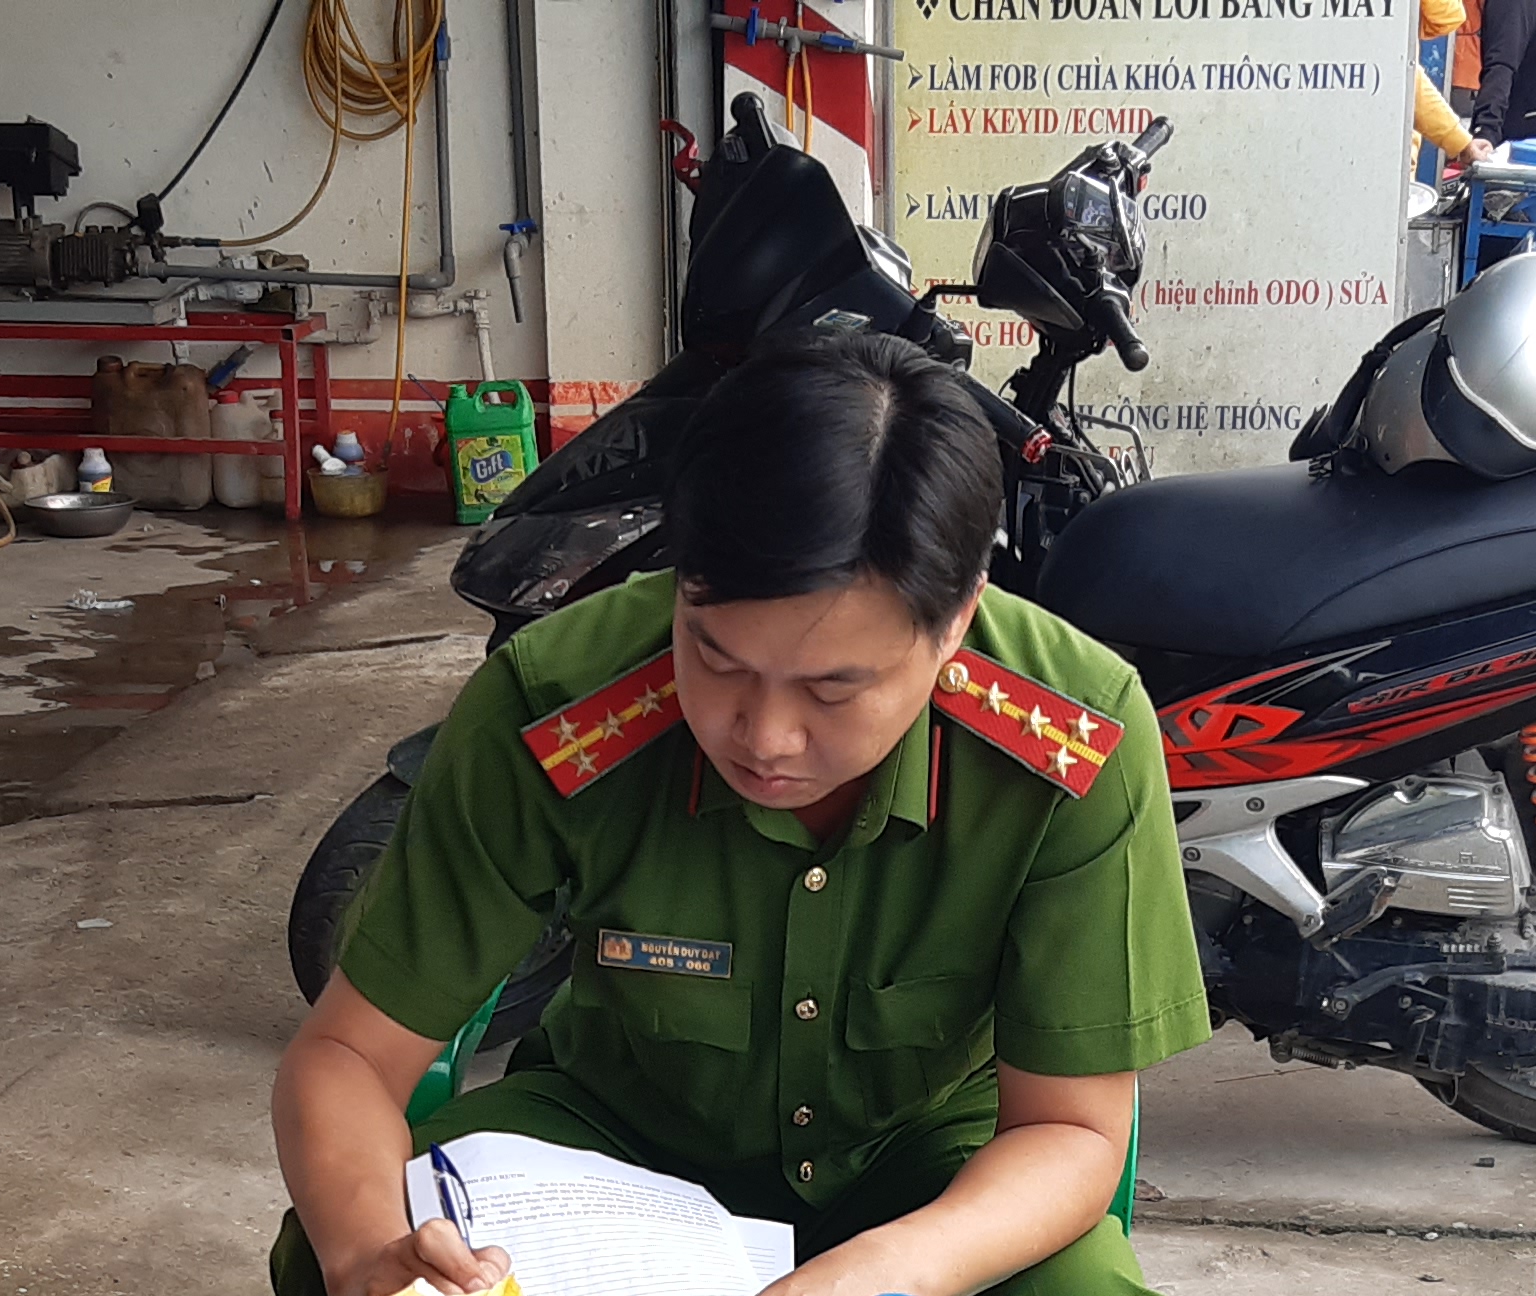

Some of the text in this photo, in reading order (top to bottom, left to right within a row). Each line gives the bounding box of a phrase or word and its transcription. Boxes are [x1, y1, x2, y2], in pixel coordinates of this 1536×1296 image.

[928, 57, 982, 91] LÀM
[989, 64, 1037, 91] FOB
[1057, 56, 1118, 91] CHÌA
[1124, 56, 1197, 91] KHÓA
[1202, 54, 1291, 91] THÔNG
[1298, 63, 1367, 90] MINH
[982, 106, 1059, 134] KEYID
[1064, 106, 1153, 134] /ECMID
[926, 186, 978, 221] LÀM
[1154, 279, 1197, 312] hiệu
[1203, 279, 1259, 306] chỉnh
[1265, 279, 1321, 306] ODO
[1339, 271, 1389, 306] SỬA
[1101, 396, 1170, 430] CÔNG
[1176, 402, 1209, 437] HỆ
[1215, 397, 1302, 430] THỐNG
[475, 453, 504, 480] Gift
